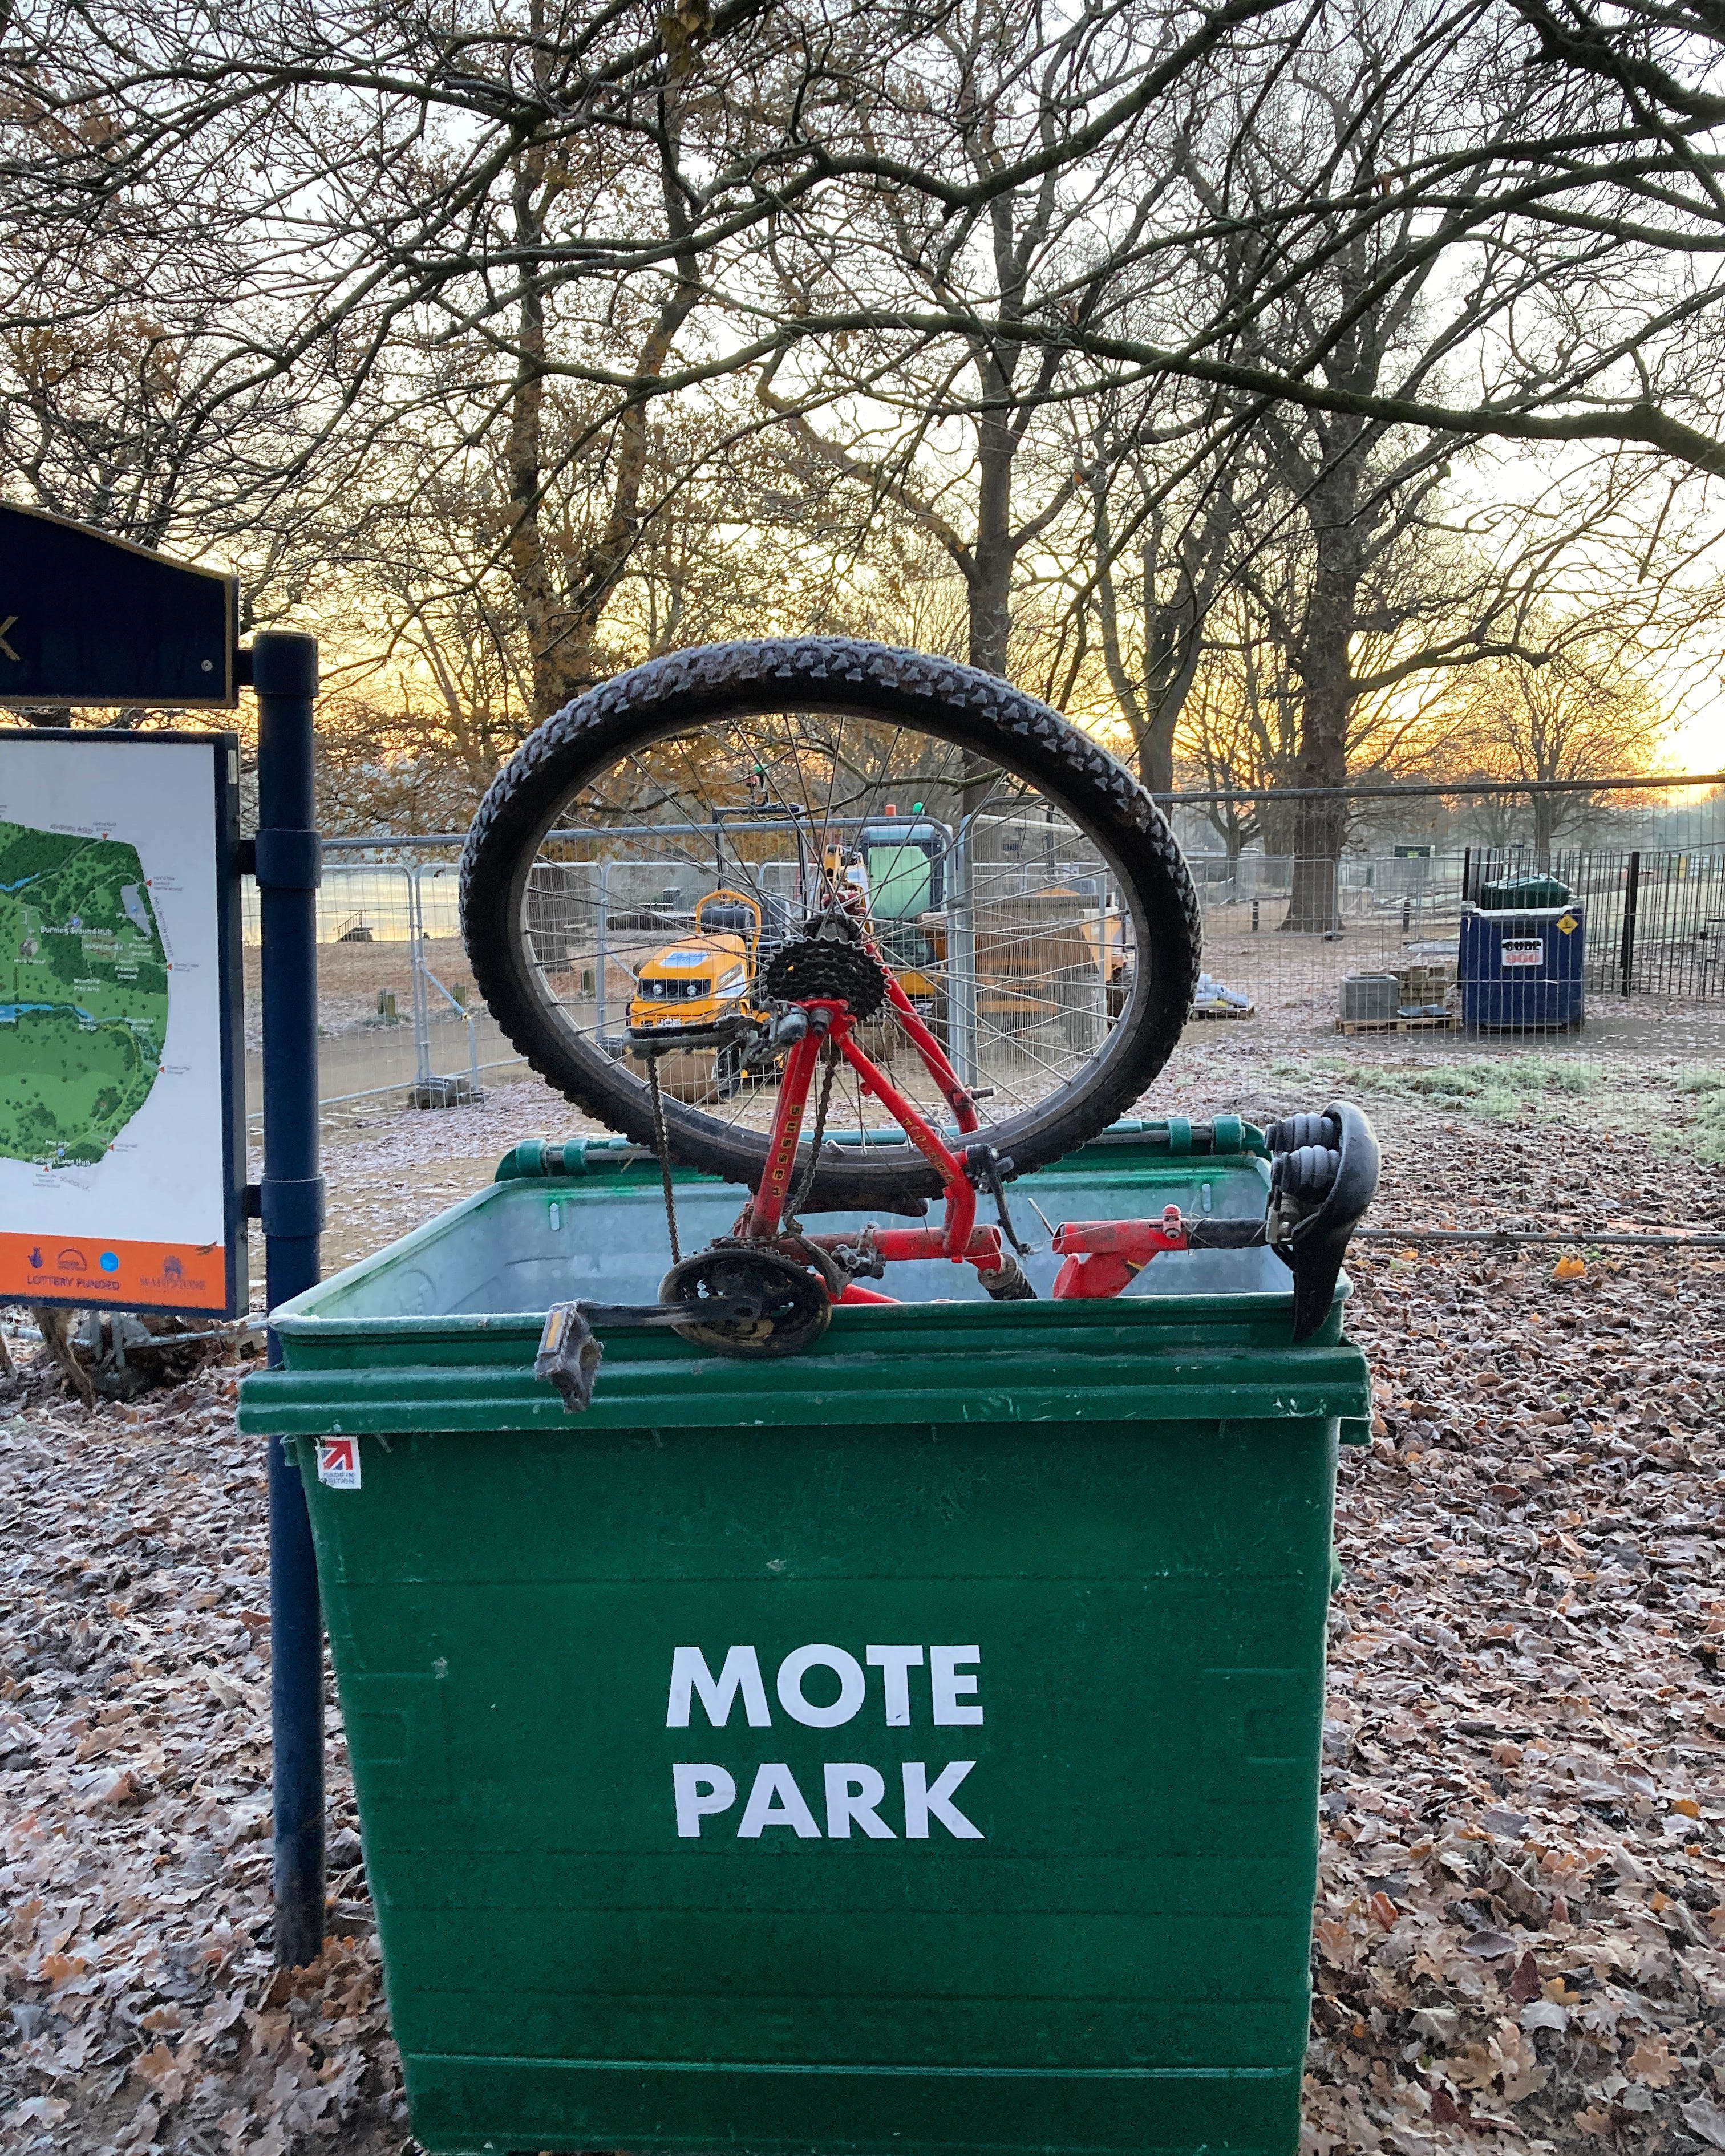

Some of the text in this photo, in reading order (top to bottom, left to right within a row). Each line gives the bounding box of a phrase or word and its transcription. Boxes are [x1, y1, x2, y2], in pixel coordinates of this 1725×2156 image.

[40, 926, 68, 935] Burning
[657, 1018, 682, 1027] JCB
[27, 1275, 120, 1291] LOTTERY FUNDED
[666, 1643, 983, 1728] MOTE
[673, 1761, 985, 1839] PARK
